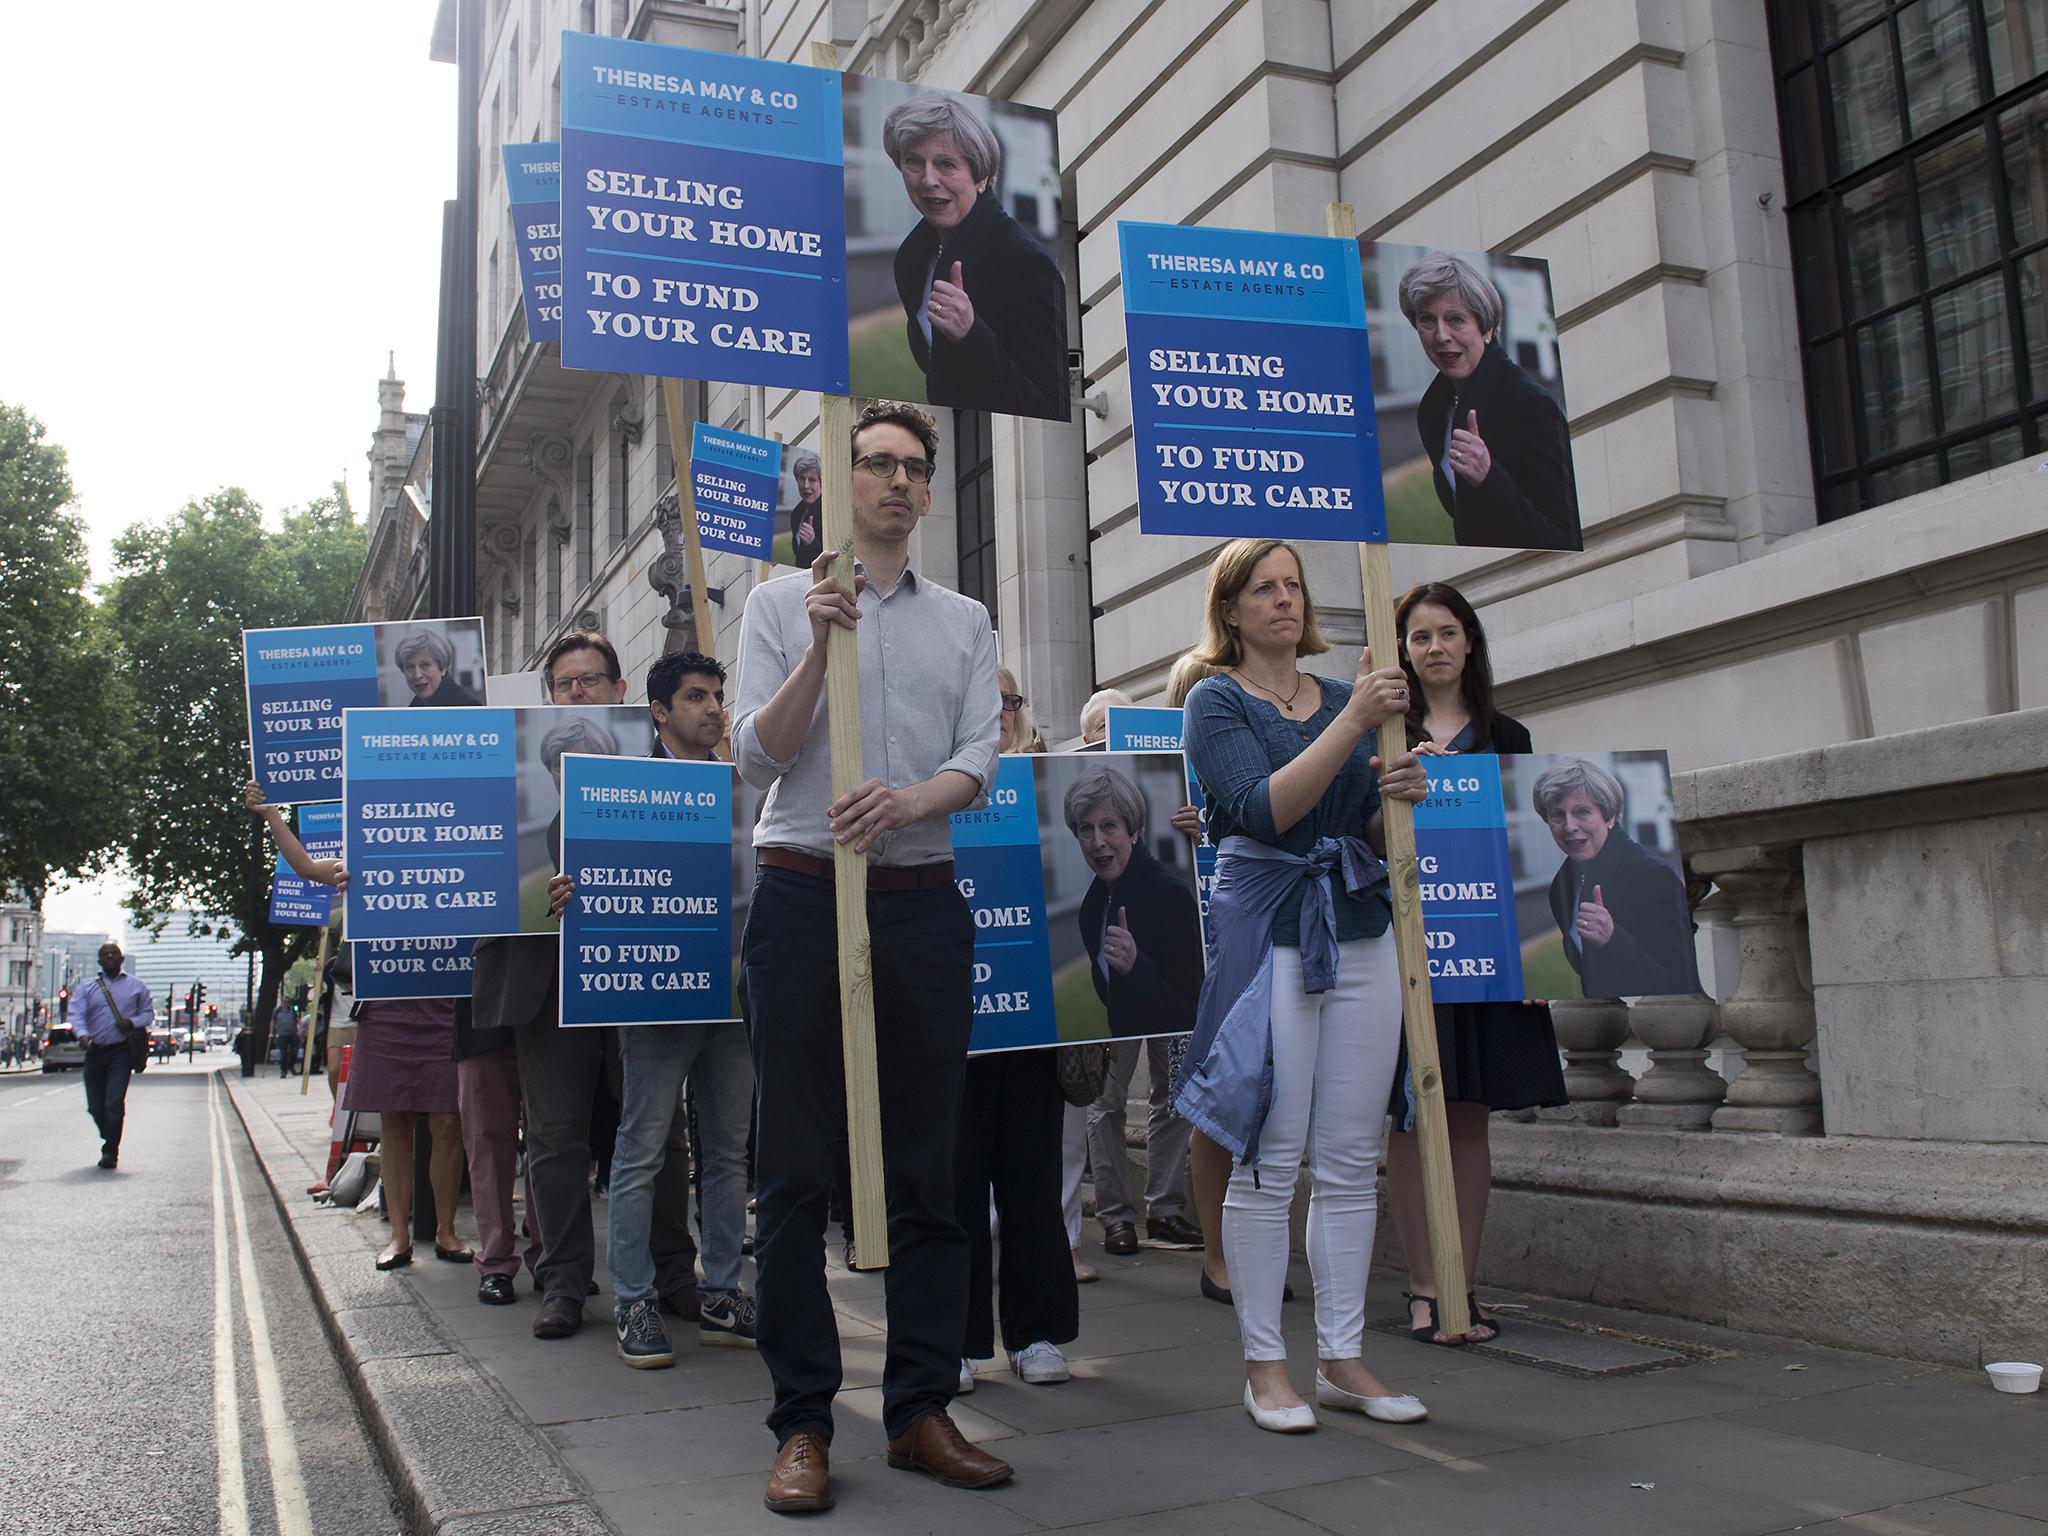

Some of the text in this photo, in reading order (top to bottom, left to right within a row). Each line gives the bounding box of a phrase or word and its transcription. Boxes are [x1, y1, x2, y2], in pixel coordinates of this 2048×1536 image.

[593, 66, 799, 110] THERESA MAY & CO
[617, 94, 774, 125] ESTATE AGENTS
[521, 162, 560, 174] THERE
[586, 169, 744, 210] SELLING
[586, 206, 698, 242] YOUR
[709, 220, 822, 257] HOME
[530, 245, 561, 261] YO
[1148, 254, 1324, 281] THERESA MAY & CO
[586, 272, 759, 312] TO FUND
[1170, 278, 1305, 296] ESTATE AGENTS
[538, 306, 562, 322] YO
[586, 310, 812, 357] YOUR CARE
[1149, 349, 1284, 378] SELLING
[1151, 384, 1354, 416] YOUR HOME
[703, 435, 735, 449] THERESA
[736, 443, 752, 453] MAY
[758, 449, 768, 457] CO
[1156, 445, 1304, 473] TO FUND
[697, 473, 746, 493] SELLING
[696, 486, 769, 512] YOUR HOME
[1159, 480, 1353, 510] YOUR CARE
[695, 511, 747, 530] TO FUND
[698, 525, 761, 547] OUR CARE
[258, 644, 363, 660] THERESA MAY & CO
[272, 659, 351, 670] ESTATE AGENTS
[262, 698, 333, 715] SELLING
[263, 716, 342, 733] YOUR HO
[362, 733, 499, 748] THERESA MAY & CO
[265, 748, 342, 765] TO FUND
[378, 751, 482, 761] ESTATE AGENTS
[267, 766, 342, 783] YOUR CA
[1443, 779, 1454, 792] &
[1458, 778, 1480, 792] CO
[581, 786, 716, 807] THERESA MAY & CO
[996, 789, 1018, 805] CO
[1411, 798, 1462, 808] GENTS
[362, 802, 456, 820] SELLING
[597, 809, 700, 822] ESTATE AGENTS
[362, 825, 503, 844] YOUR HOME
[306, 841, 342, 850] SELLIN
[362, 867, 465, 887] TO FUND
[580, 868, 673, 887] SELLING
[362, 891, 497, 911] YOUR CARE
[1419, 882, 1497, 901] HOME
[580, 896, 718, 915] YOUR HOME
[970, 906, 1031, 928] OME
[368, 937, 458, 952] TO FUND
[580, 944, 680, 963] TO FUND
[369, 956, 477, 974] YOUR CAR
[1427, 958, 1496, 977] CARE
[580, 972, 710, 992] YOUR CARE
[973, 991, 1030, 1014] ARE
